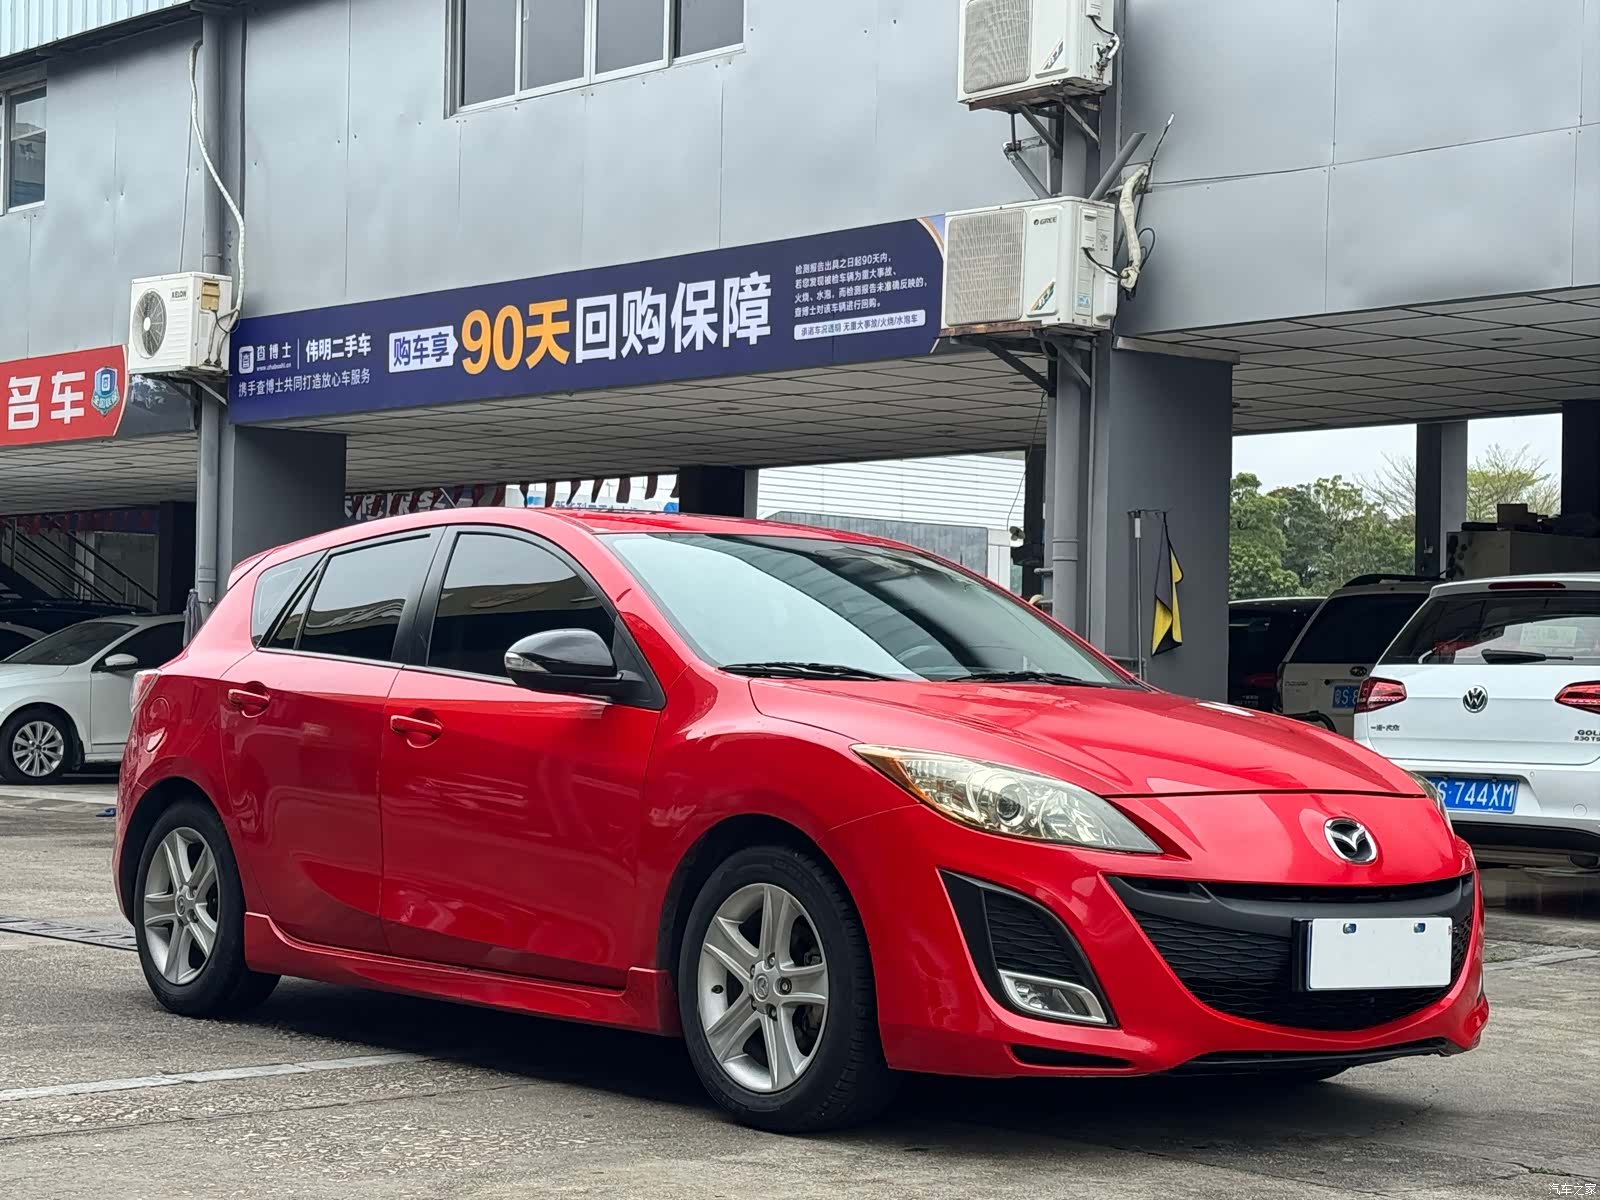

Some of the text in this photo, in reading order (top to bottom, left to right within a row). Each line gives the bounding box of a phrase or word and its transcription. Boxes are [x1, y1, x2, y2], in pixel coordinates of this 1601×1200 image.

[305, 333, 372, 363] 伟明二手车
[393, 331, 450, 367] 购车享
[238, 368, 371, 397] 携手查博士共同打造放心车服务
[8, 370, 86, 430] 名车
[1431, 781, 1515, 807] S·744XM
